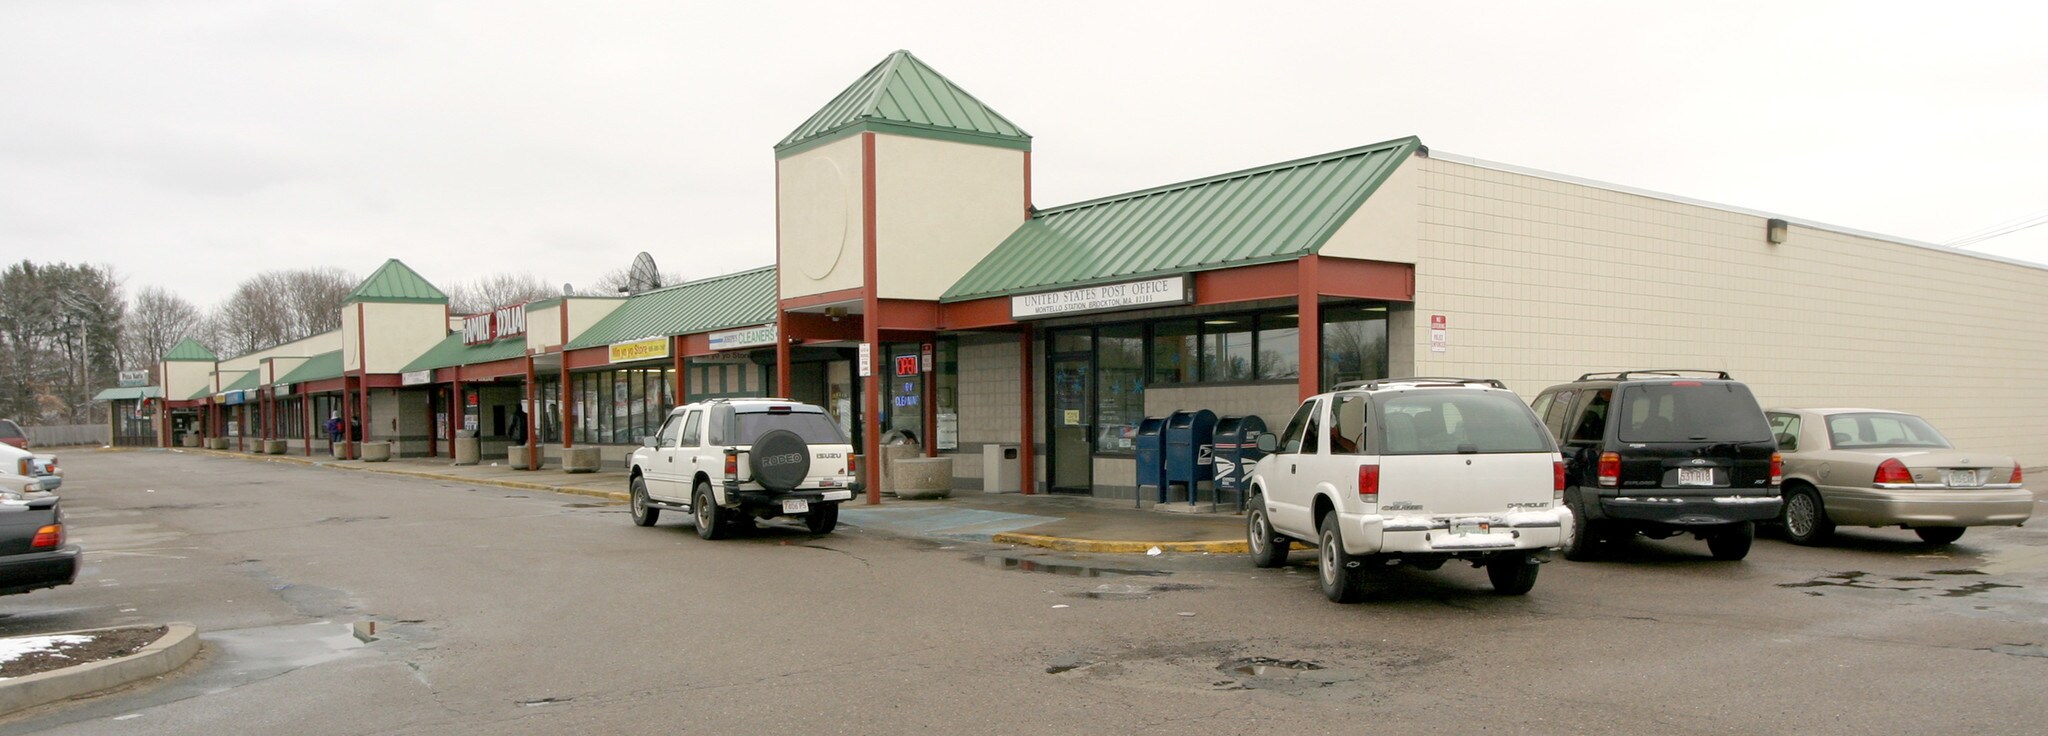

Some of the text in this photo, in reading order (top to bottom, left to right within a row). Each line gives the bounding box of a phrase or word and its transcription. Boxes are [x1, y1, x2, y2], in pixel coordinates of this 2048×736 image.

[1024, 280, 1169, 307] UNITED STATES POST OFFICE
[1034, 304, 1063, 313] MONTELLO
[463, 314, 490, 344] FAMILY
[738, 328, 775, 345] CLEANERS
[761, 452, 802, 468] RODEO
